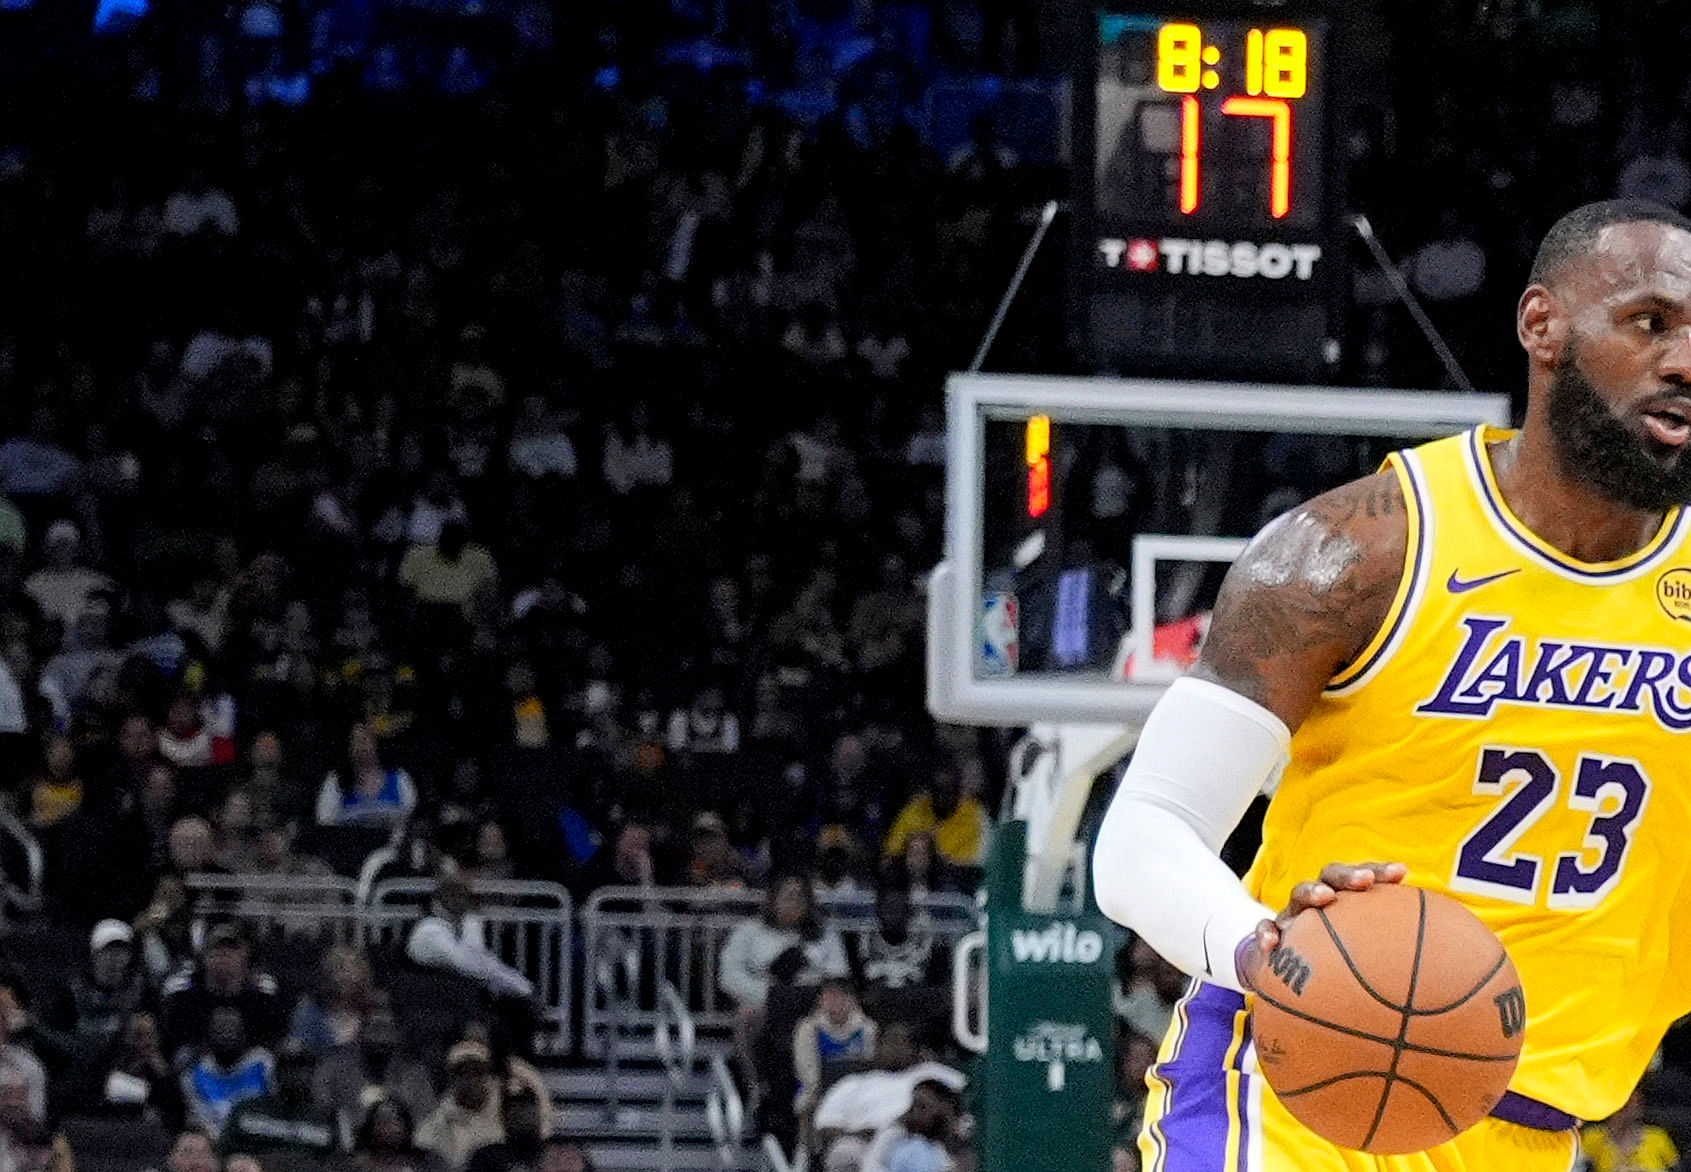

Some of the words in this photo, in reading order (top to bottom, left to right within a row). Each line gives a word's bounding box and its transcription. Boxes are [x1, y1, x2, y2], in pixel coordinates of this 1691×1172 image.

[1158, 23, 1308, 98] 8:18
[1179, 95, 1292, 218] 17
[1159, 238, 1322, 280] TISSOT
[1451, 745, 1651, 908] 23
[1011, 921, 1103, 963] wilo
